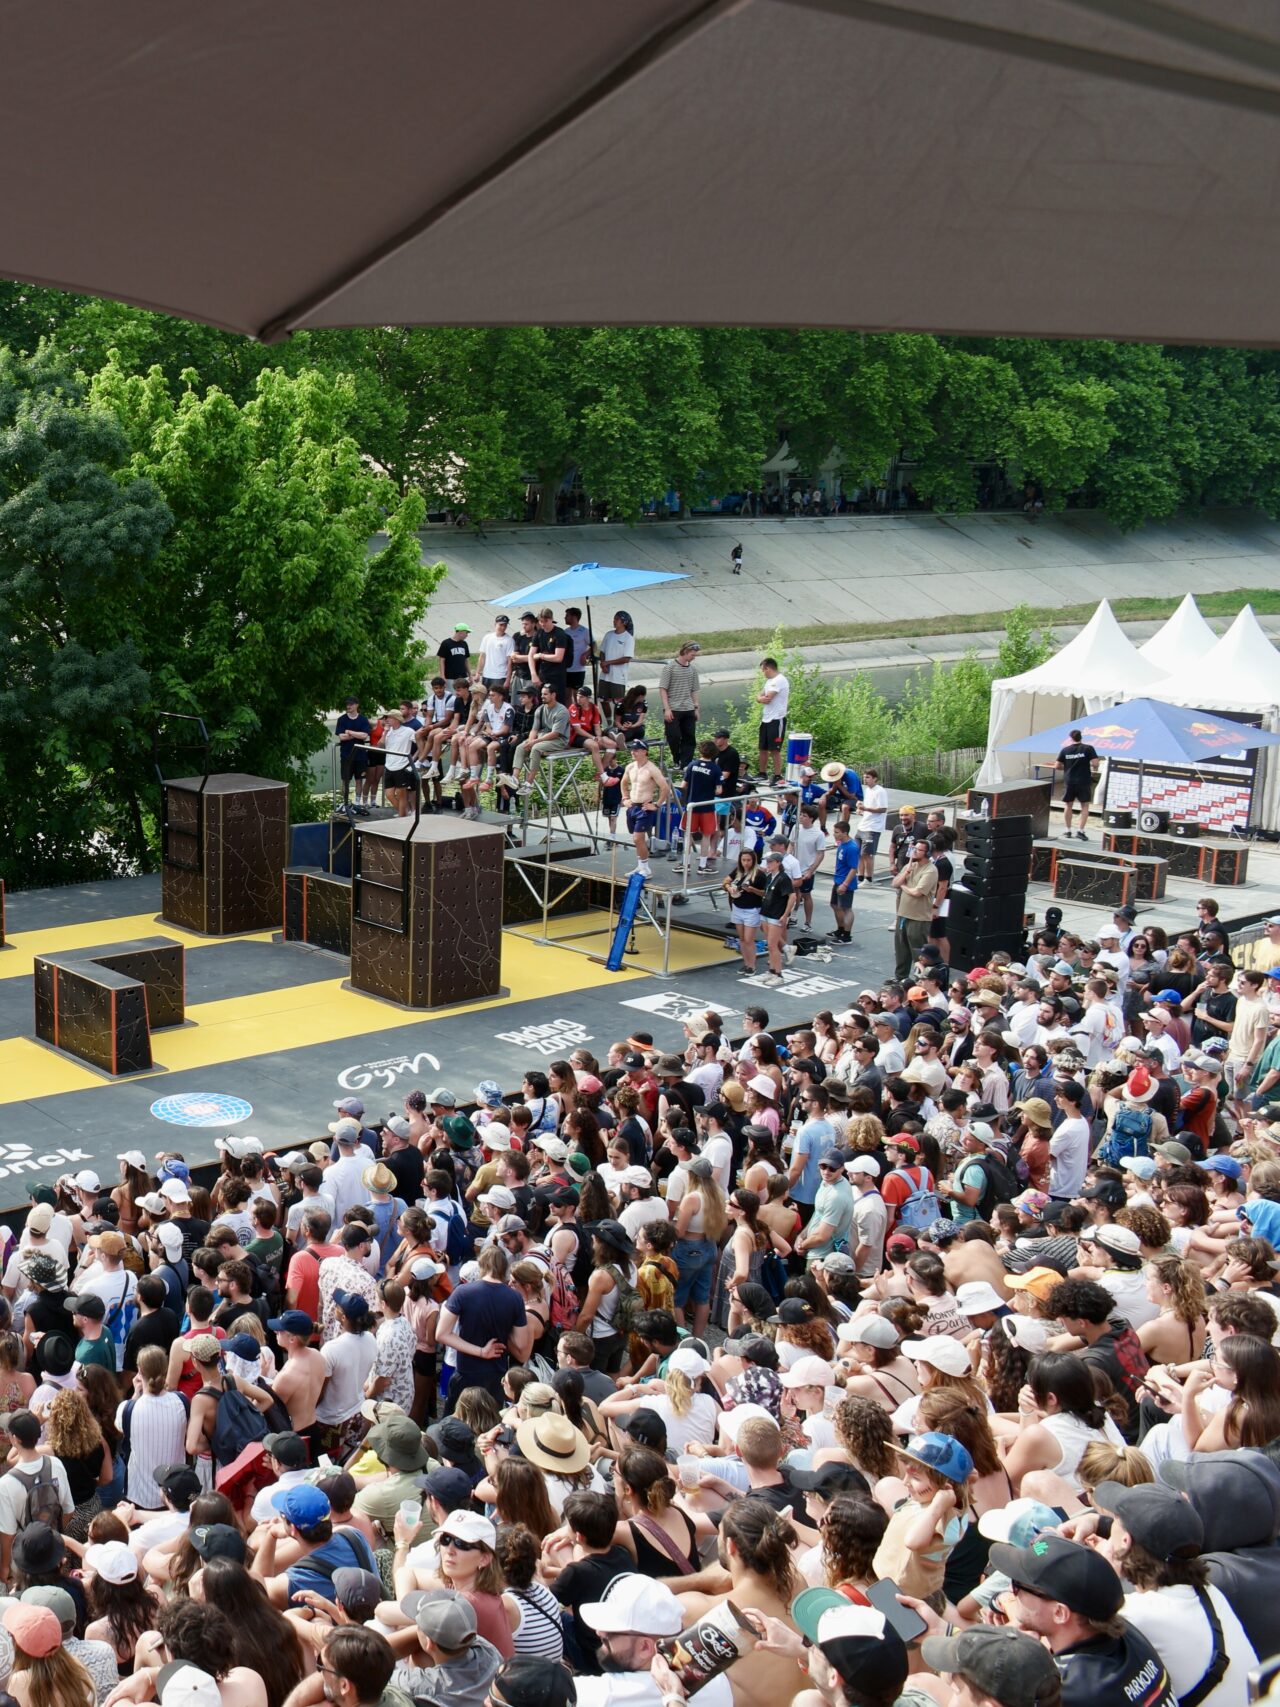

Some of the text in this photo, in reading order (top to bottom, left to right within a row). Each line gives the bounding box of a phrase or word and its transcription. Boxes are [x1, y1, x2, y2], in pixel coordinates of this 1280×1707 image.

[661, 805, 679, 814] ITLIA
[494, 1018, 587, 1046] Riding
[524, 1030, 595, 1056] zone
[337, 1052, 441, 1090] Gym
[1123, 1659, 1159, 1702] PARKOUR
